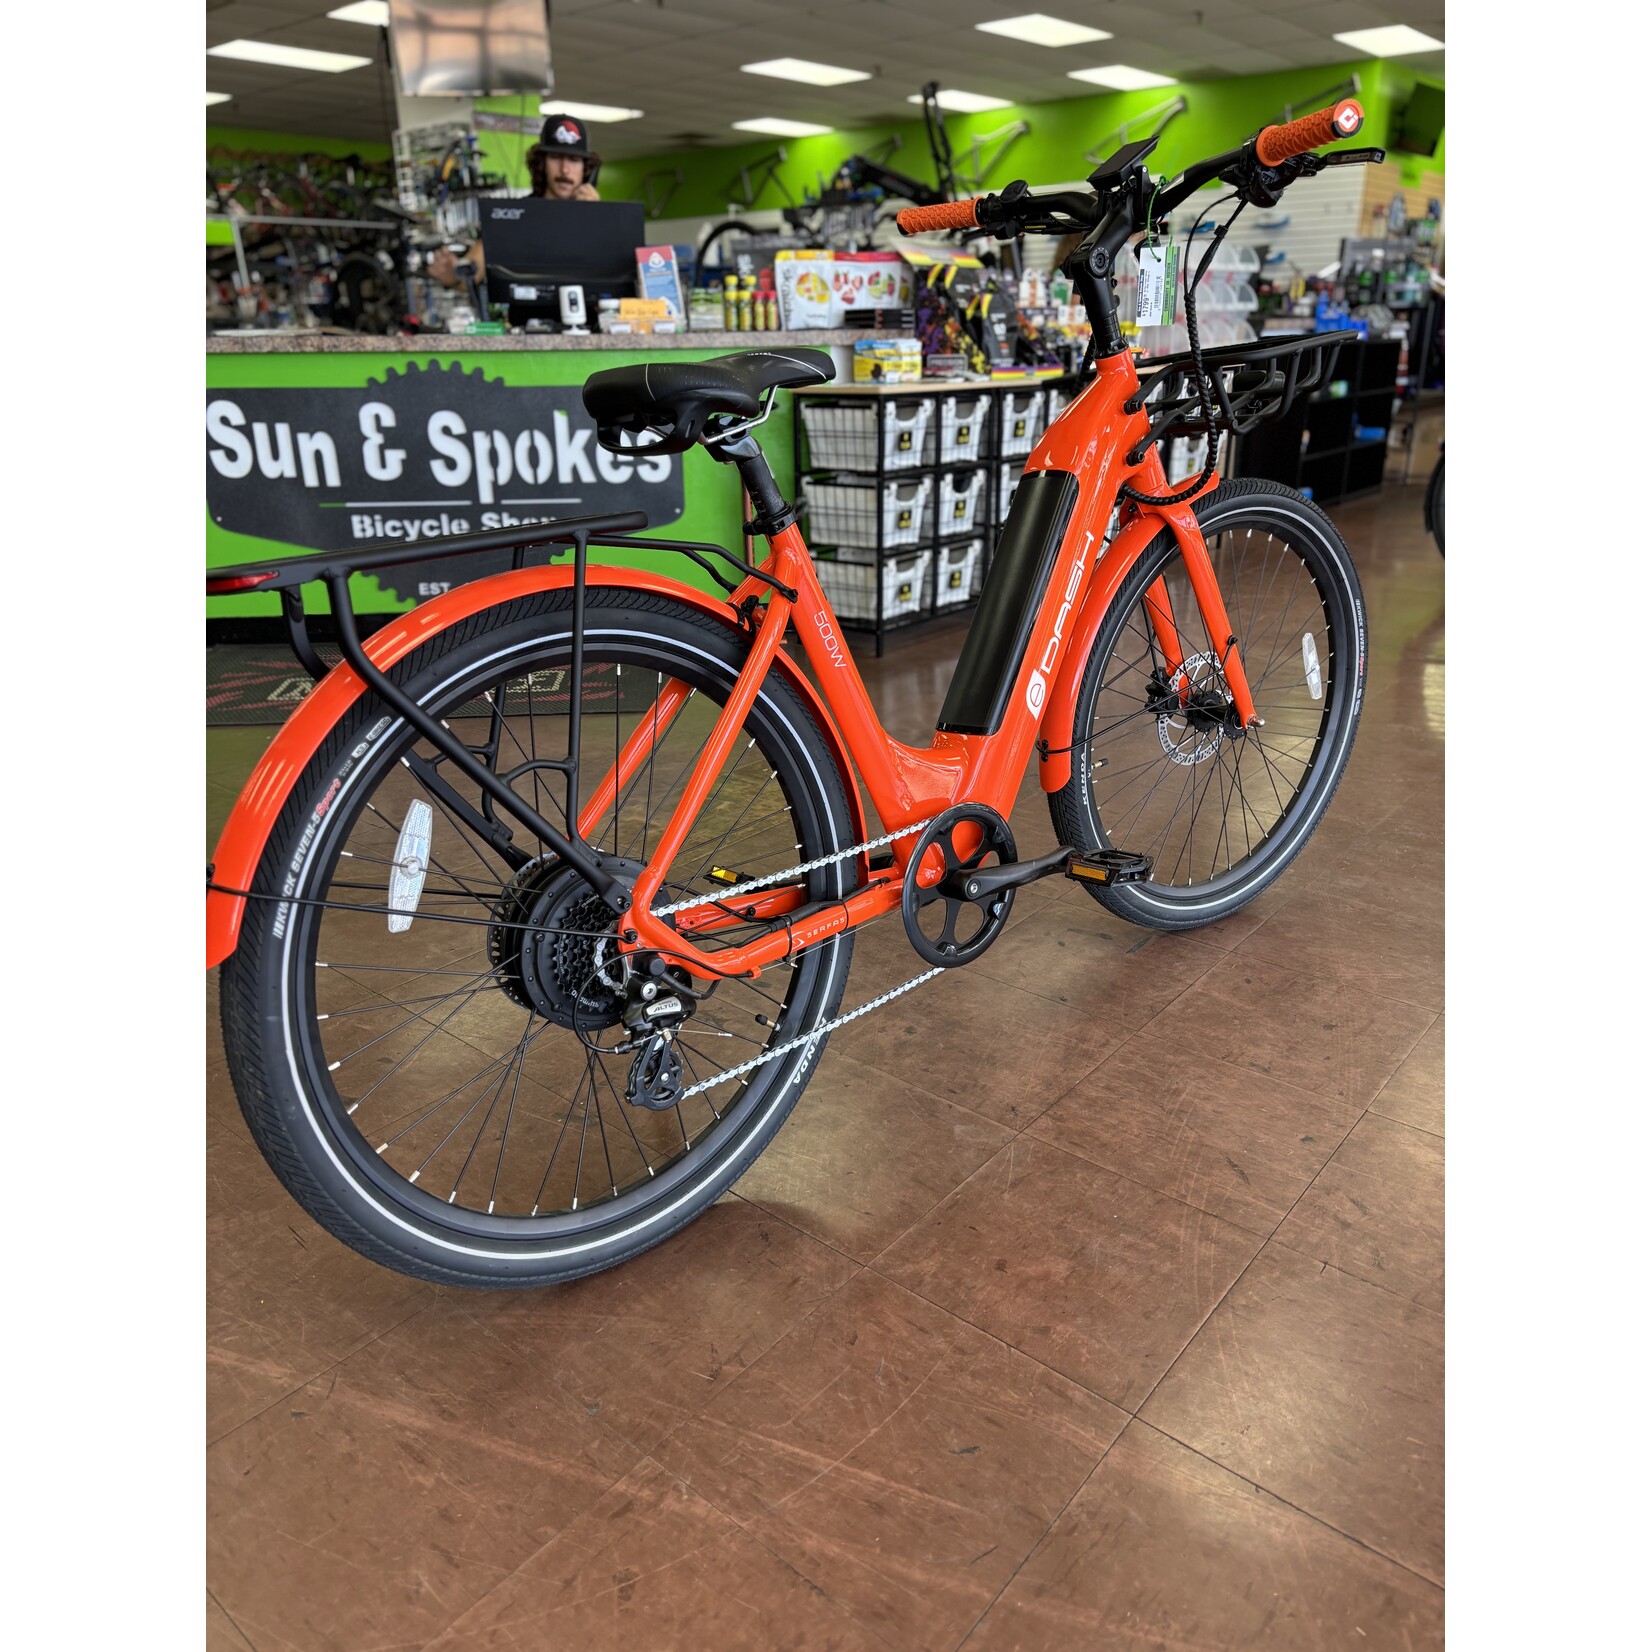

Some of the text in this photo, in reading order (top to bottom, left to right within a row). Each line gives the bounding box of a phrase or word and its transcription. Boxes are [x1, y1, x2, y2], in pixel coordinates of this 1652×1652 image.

[491, 208, 525, 220] acer
[206, 400, 673, 505] Sun & Spokes
[351, 513, 470, 542] Bicycle
[1039, 531, 1095, 674] DASH
[813, 610, 847, 668] 500W
[1080, 752, 1088, 806] KENDA
[291, 810, 321, 874] SEVEN-5
[315, 778, 342, 817] Sport
[806, 916, 846, 938] SERFAS
[653, 1002, 679, 1013] ALTUS
